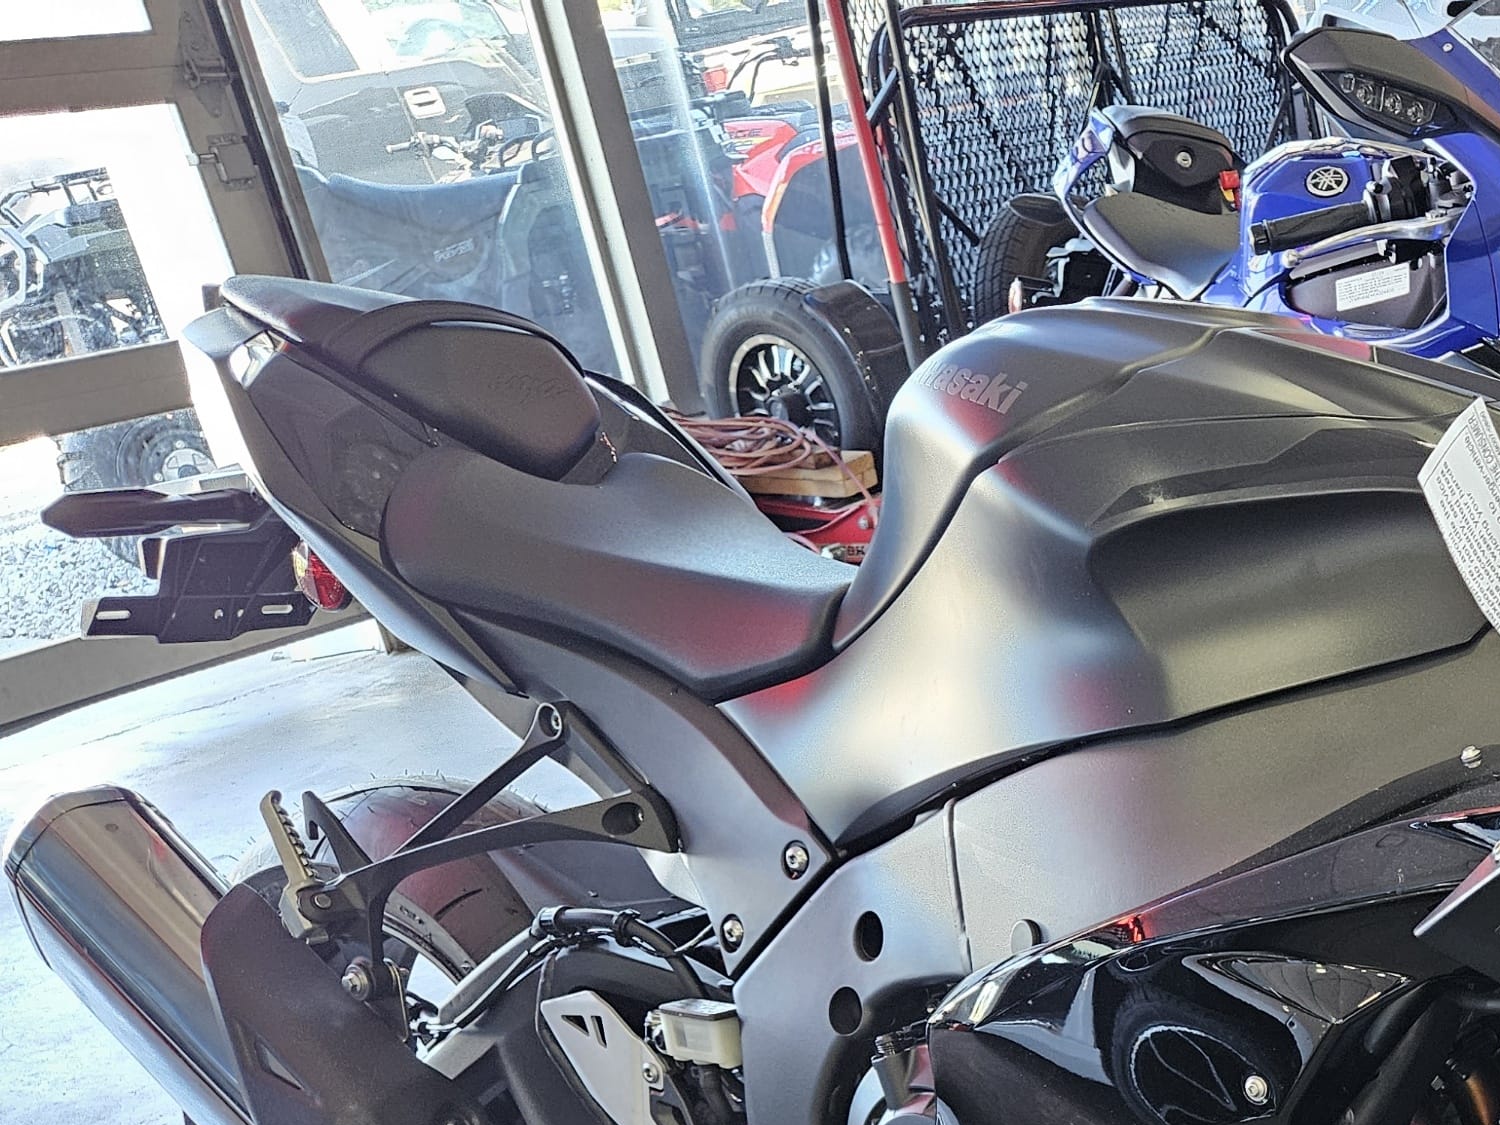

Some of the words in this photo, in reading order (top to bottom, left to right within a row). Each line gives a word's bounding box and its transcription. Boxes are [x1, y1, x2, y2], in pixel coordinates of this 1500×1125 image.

[1438, 468, 1457, 497] area
[1441, 459, 1466, 499] hands
[1434, 474, 1460, 519] service
[1437, 498, 1451, 520] the
[1464, 489, 1485, 519] your
[1462, 499, 1481, 529] your
[1447, 520, 1464, 543] idle
[1475, 528, 1498, 561] wash
